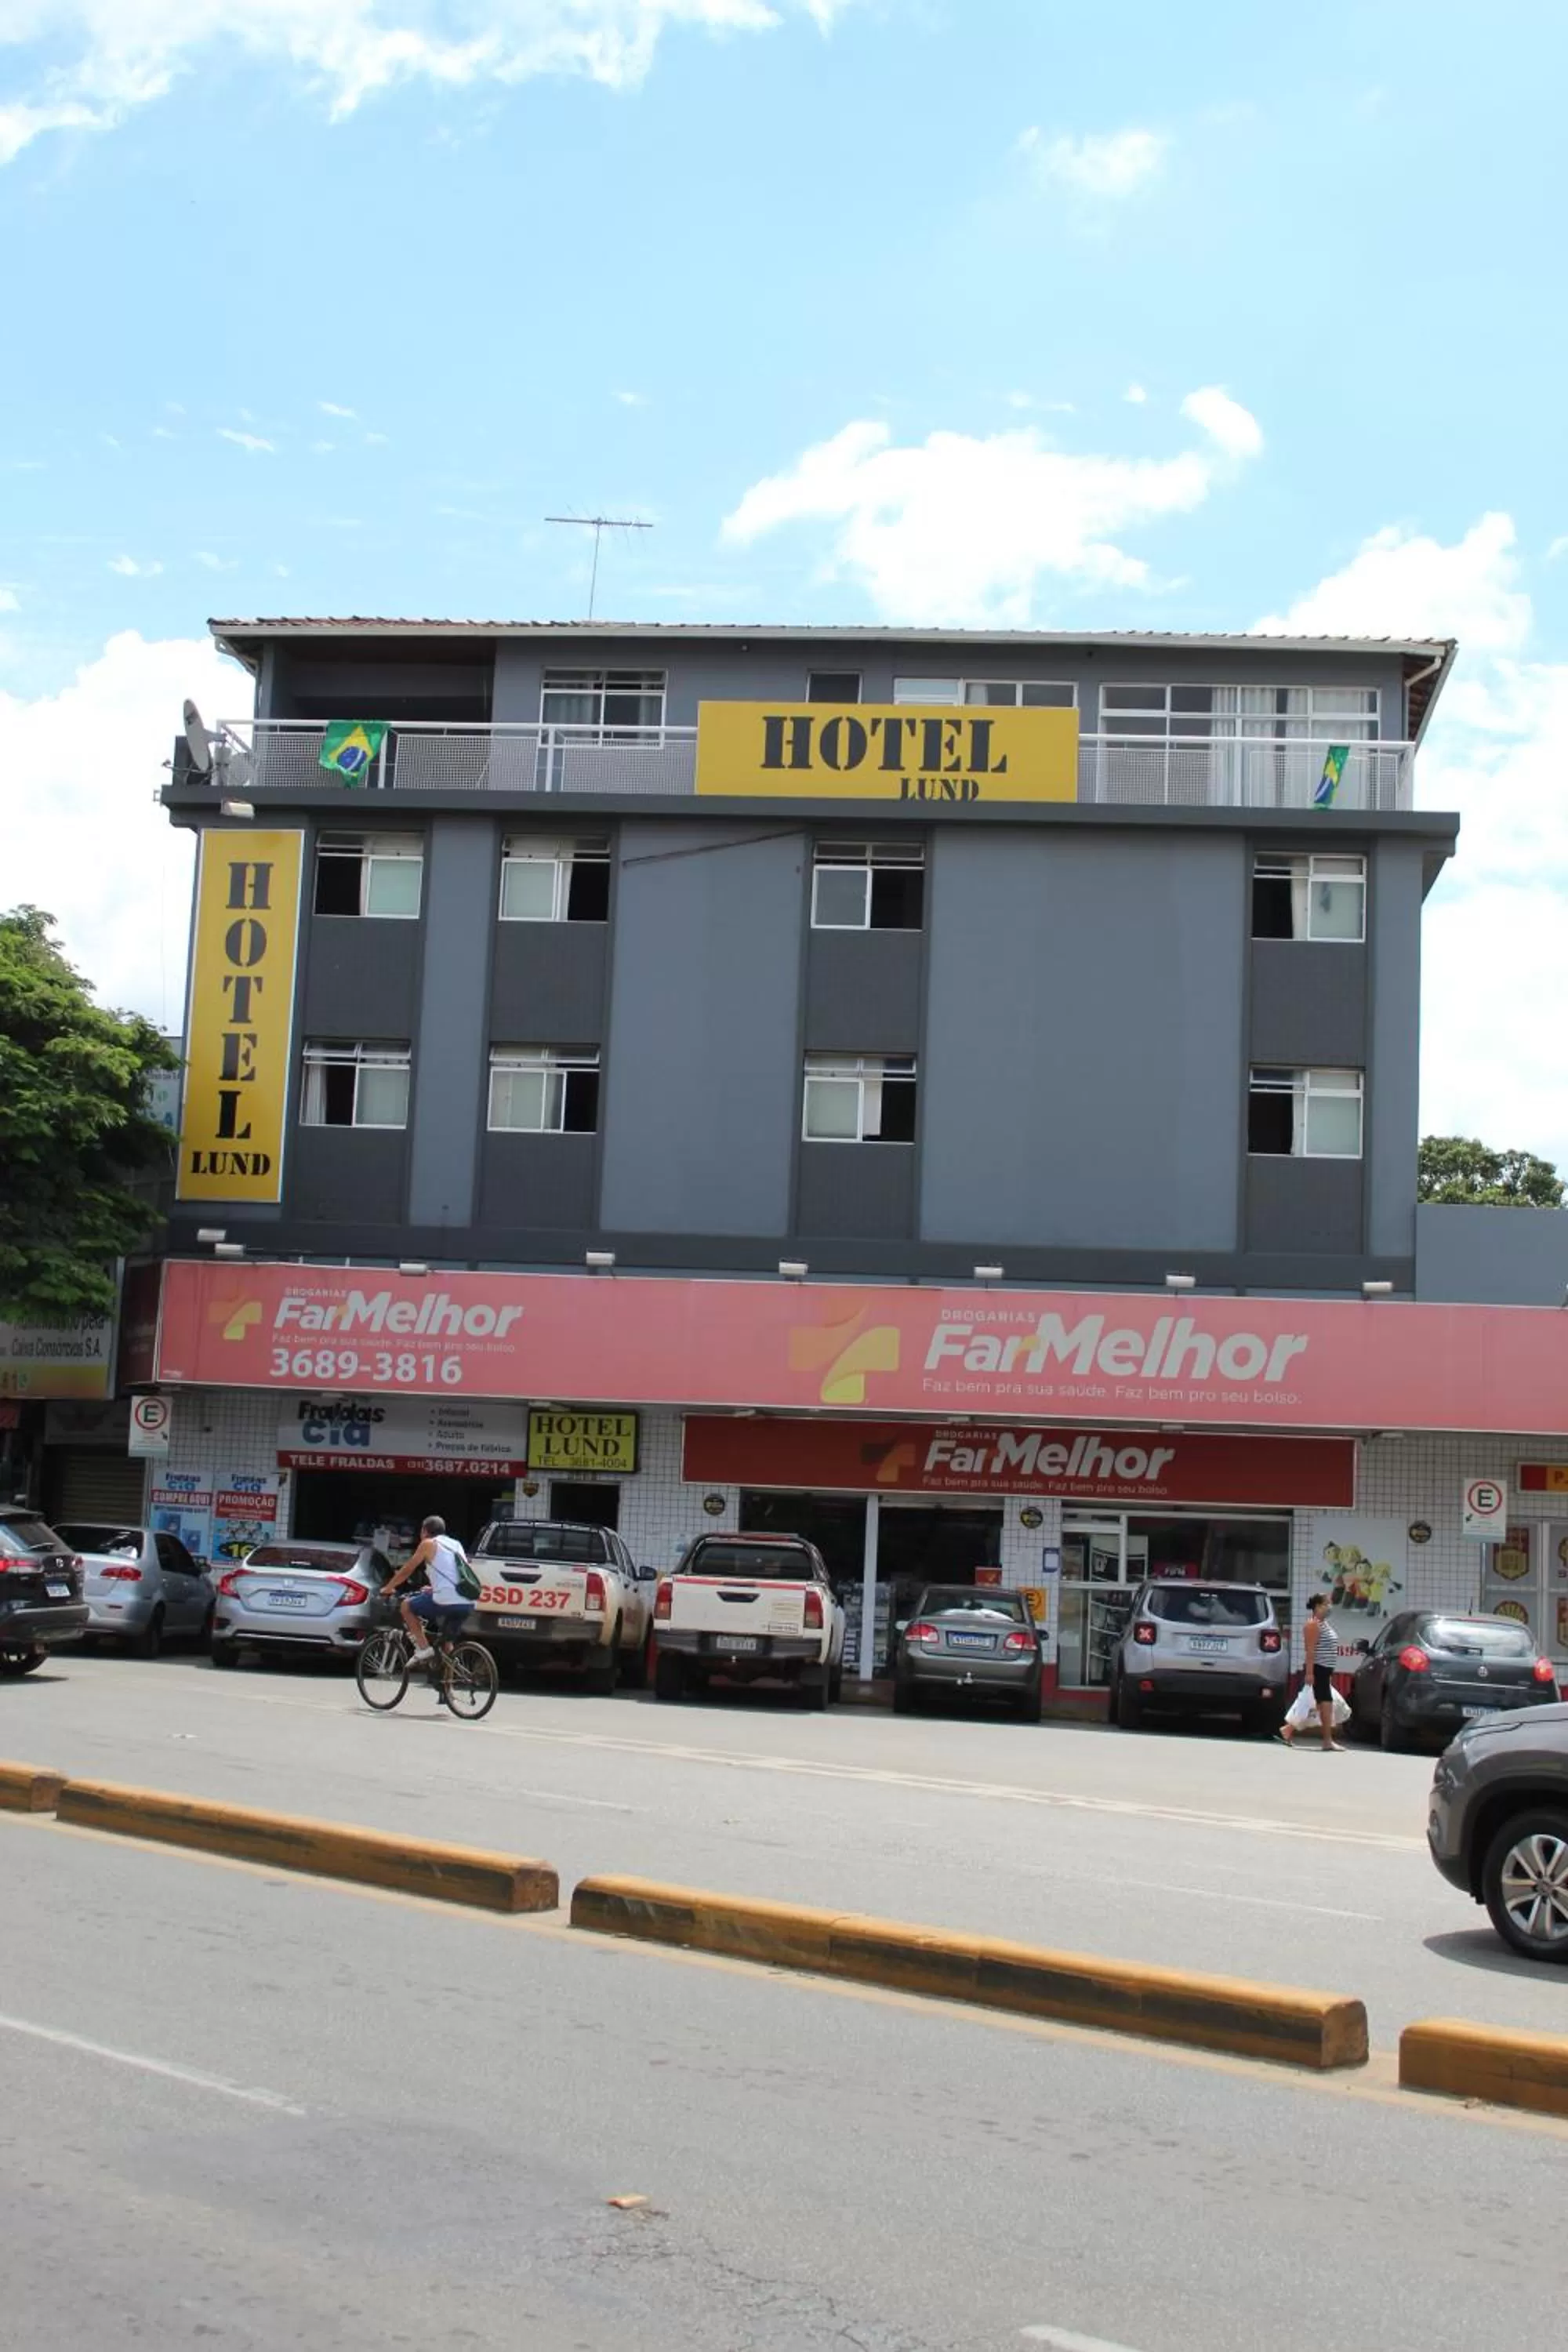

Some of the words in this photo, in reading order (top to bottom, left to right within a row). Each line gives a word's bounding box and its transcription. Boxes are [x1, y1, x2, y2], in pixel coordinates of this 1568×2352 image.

[760, 716, 1007, 773] HOTEL
[899, 777, 979, 802] LUND
[216, 862, 274, 1139] HOTEL
[191, 1151, 270, 1174] LUND
[285, 1287, 347, 1298] DROGARIAS
[274, 1290, 524, 1338] FarMelhor
[941, 1309, 1036, 1323] DROGARIAS
[272, 1333, 291, 1343] Faz
[924, 1312, 1309, 1381] FarMelhor
[270, 1348, 462, 1385] 3689-3816
[923, 1378, 950, 1392] Faz
[956, 1379, 991, 1393] bem
[996, 1381, 1022, 1396] pra
[1026, 1383, 1054, 1396] sua
[1116, 1385, 1142, 1399] Faz
[1149, 1386, 1184, 1400] bem
[1189, 1390, 1216, 1403] pro
[1221, 1391, 1249, 1403] seu
[143, 1404, 158, 1423] E
[298, 1399, 387, 1422] Fraldas
[536, 1415, 631, 1437] HOTEL
[935, 1429, 998, 1440] DROGARIAS
[544, 1436, 620, 1456] LUND
[924, 1432, 1175, 1481] FarMelhor
[289, 1454, 325, 1467] TELE
[330, 1455, 396, 1469] FRALDAS
[425, 1458, 510, 1475] 3687.0214
[945, 1476, 968, 1487] bem
[219, 1493, 274, 1508] PROMOÇÃO
[1478, 1488, 1493, 1508] E
[477, 1585, 523, 1605] GSD
[528, 1589, 571, 1609] 237
